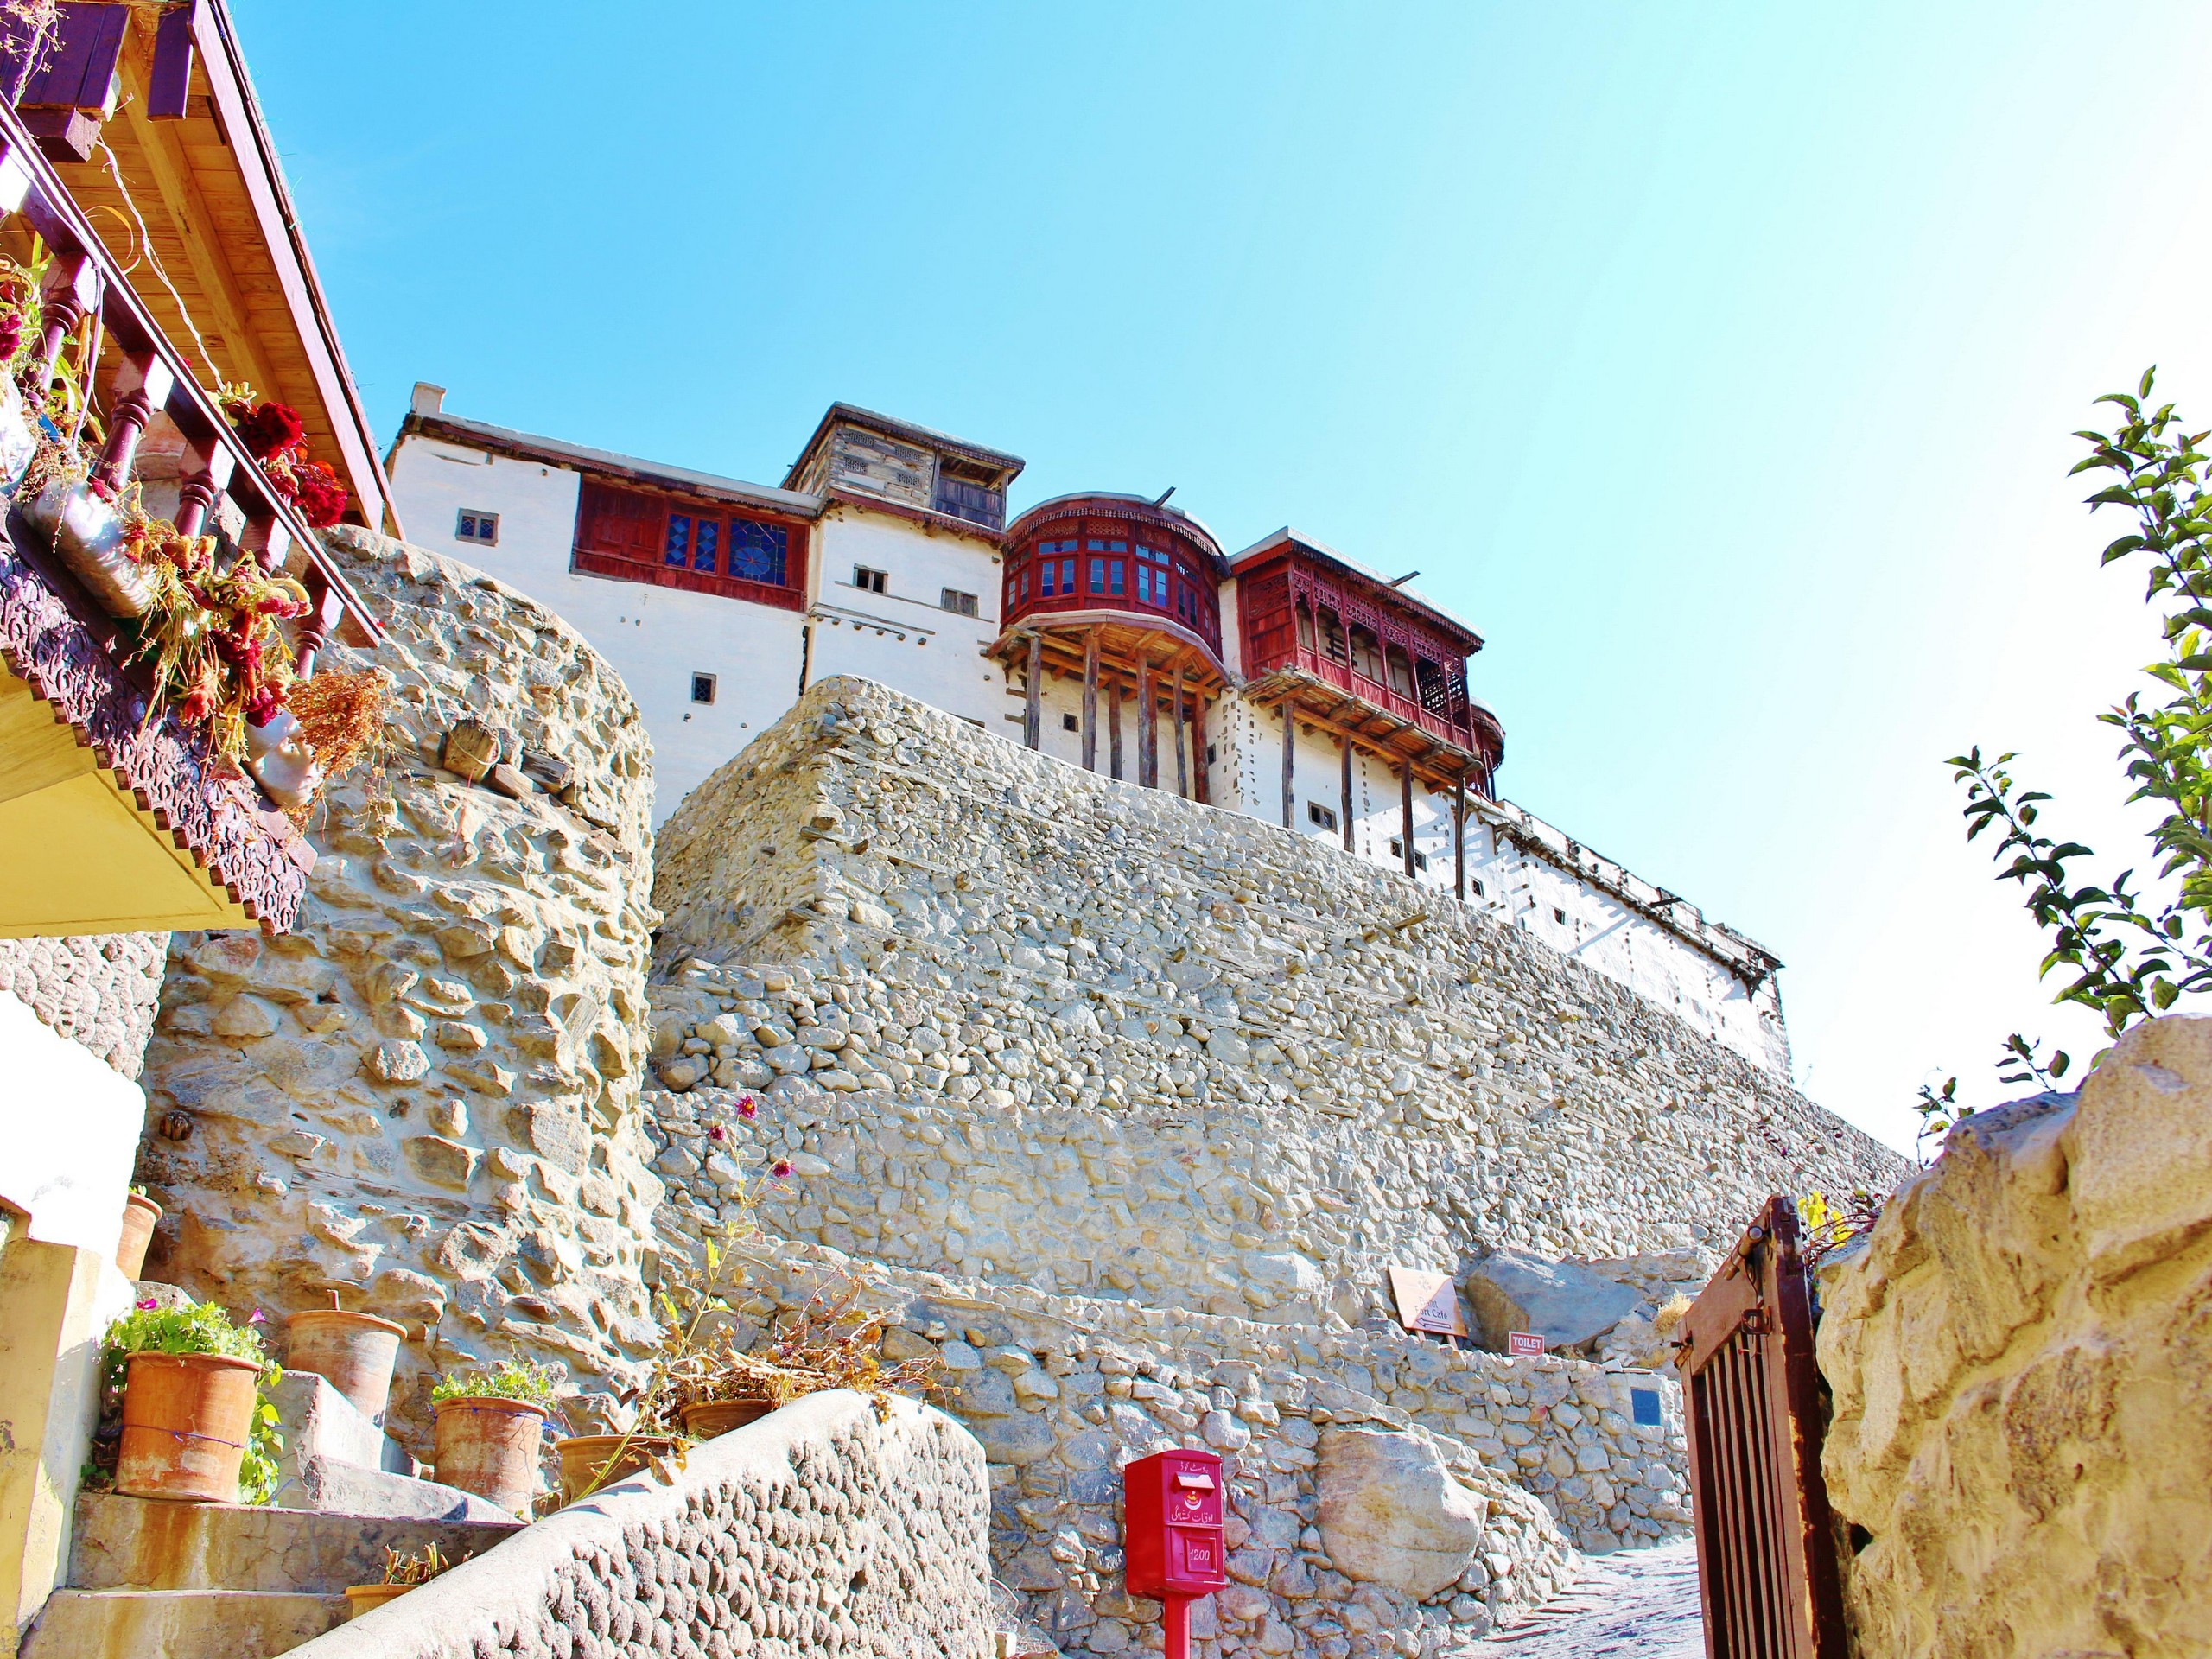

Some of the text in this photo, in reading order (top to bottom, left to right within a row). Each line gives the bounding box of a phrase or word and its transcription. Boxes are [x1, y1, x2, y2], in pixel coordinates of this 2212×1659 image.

[1512, 1336, 1541, 1349] TOILET
[1192, 1512, 1213, 1523] اوقات
[1190, 1548, 1210, 1560] 1200
